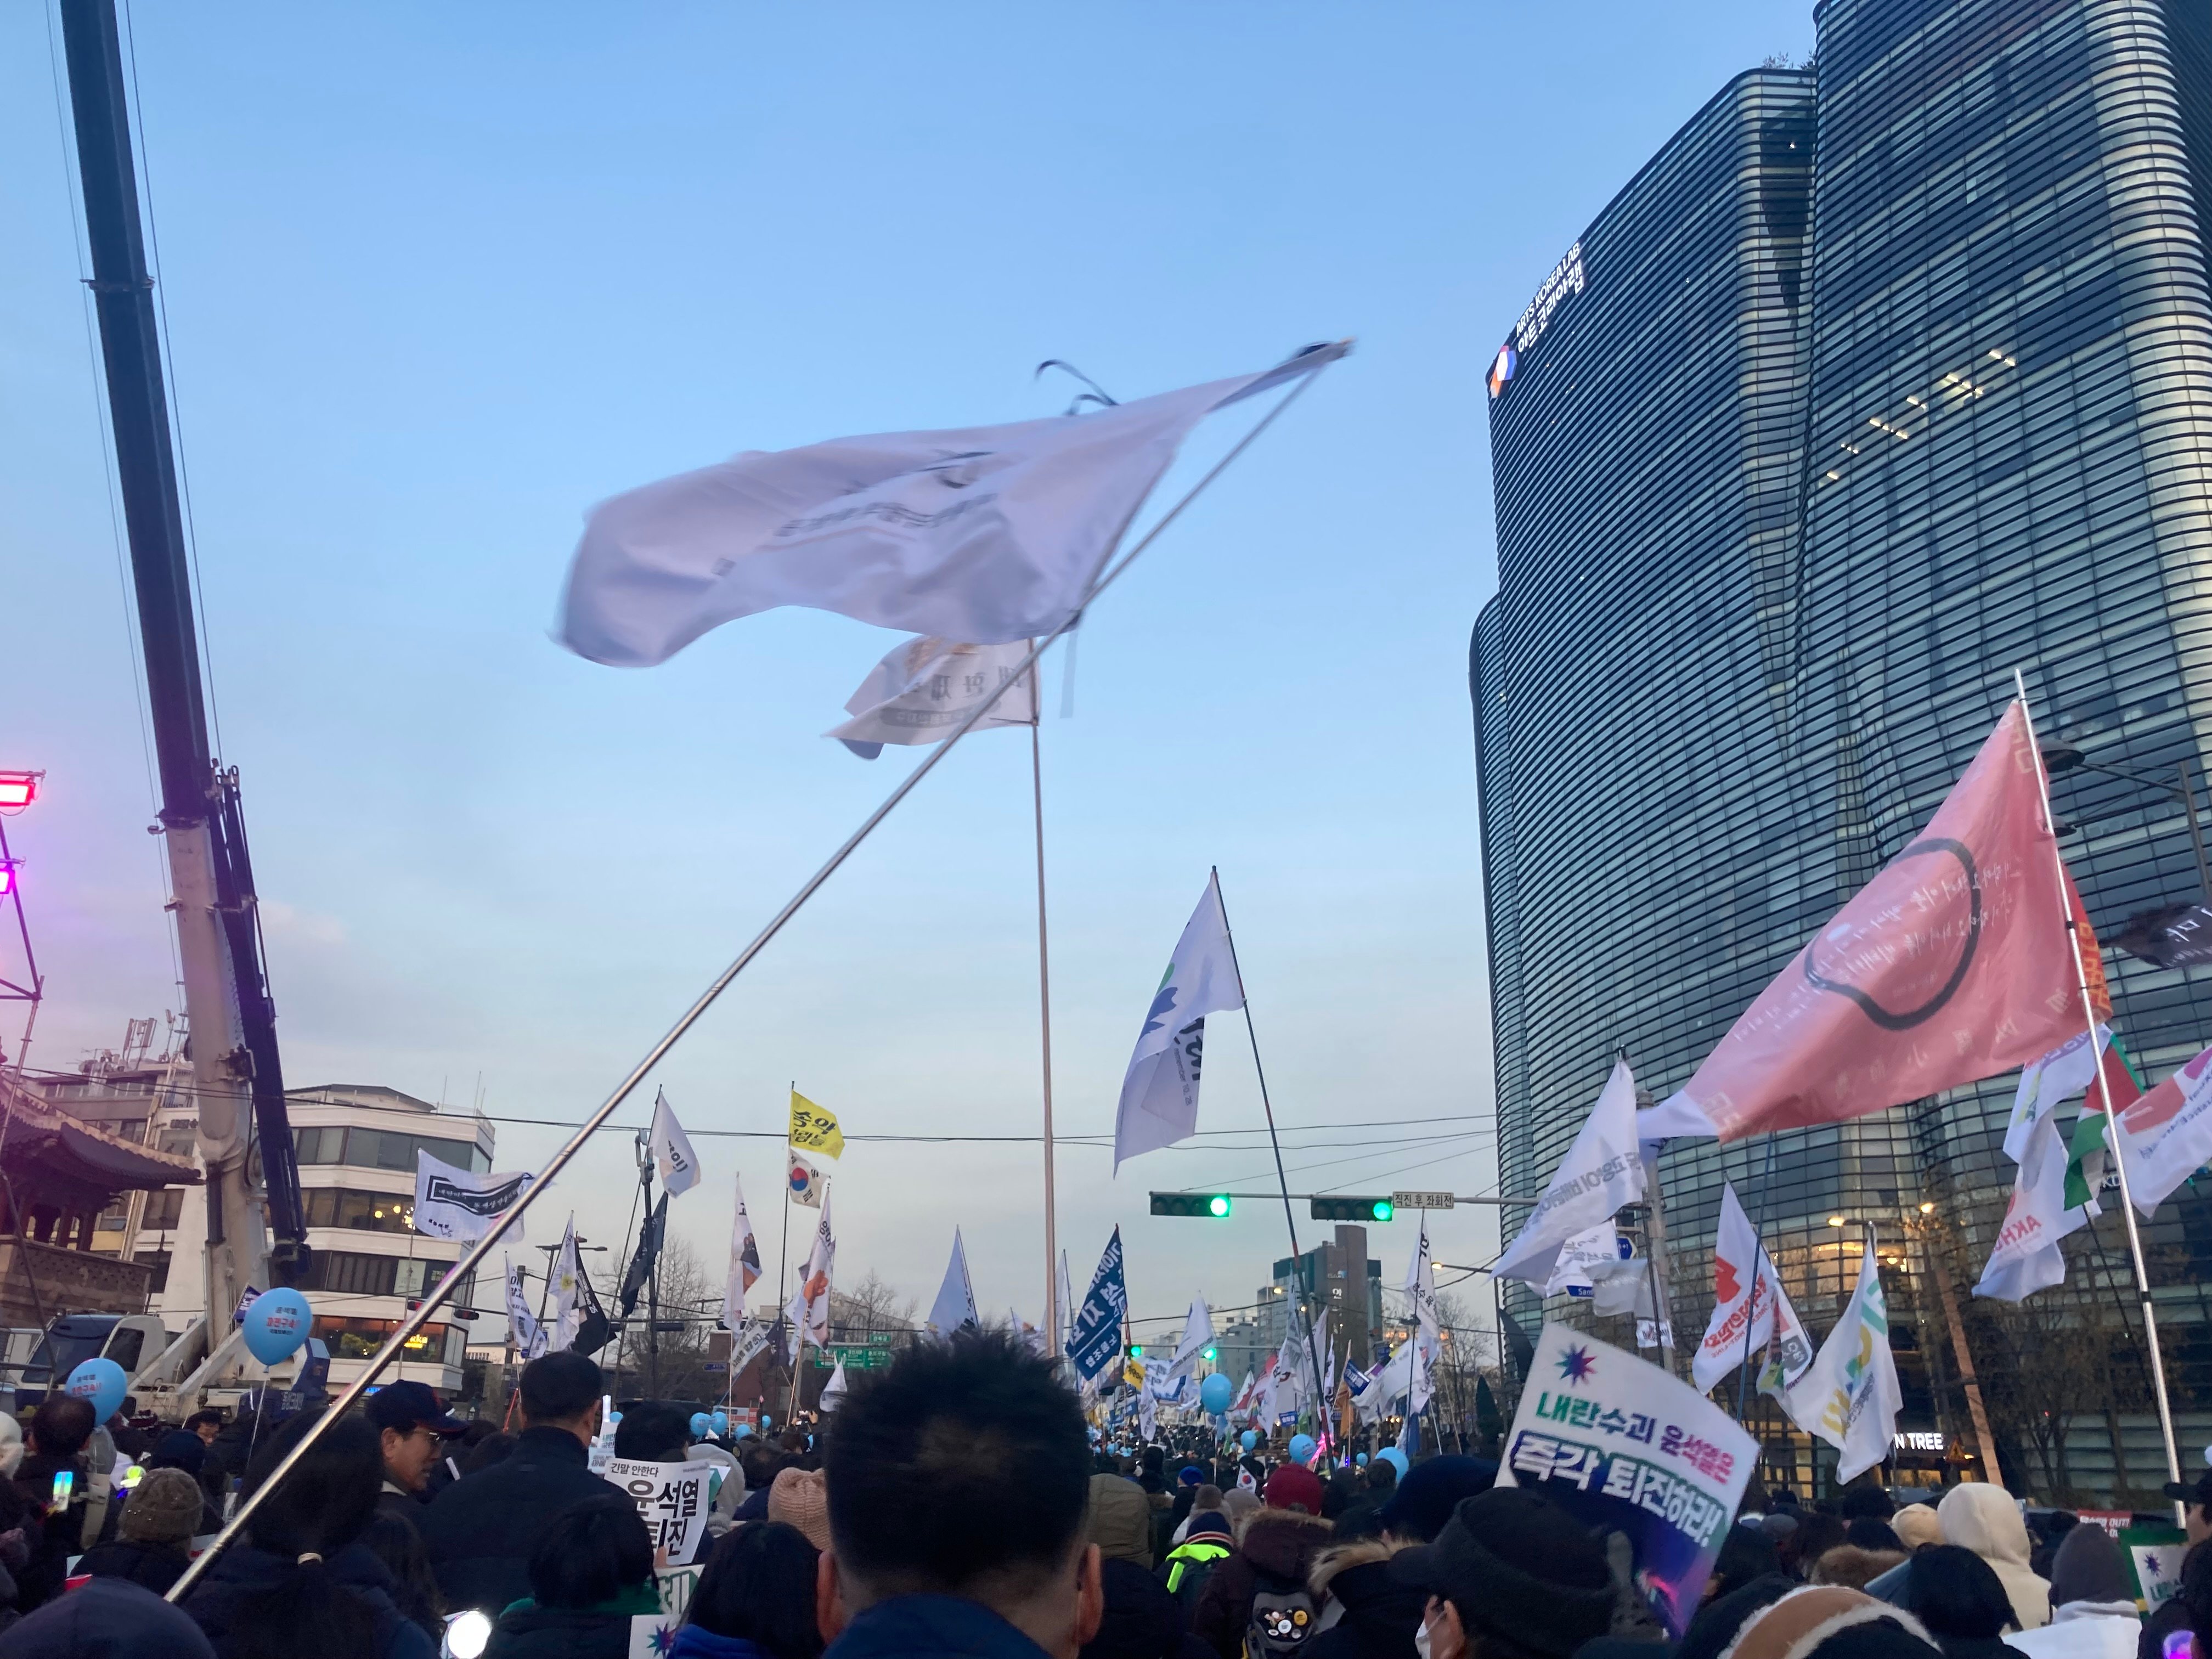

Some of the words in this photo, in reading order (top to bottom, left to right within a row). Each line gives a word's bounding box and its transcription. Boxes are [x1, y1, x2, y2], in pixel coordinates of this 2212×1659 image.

[1516, 302, 1534, 337] ARTS
[1534, 267, 1564, 309] KOREA
[1562, 242, 1581, 272] LAB
[1517, 259, 1584, 353] 아트코리아랩
[1395, 1194, 1412, 1206] 직진
[1415, 1193, 1423, 1206] 후
[1426, 1194, 1452, 1207] 좌회전
[611, 1462, 630, 1475] 긴말
[631, 1465, 659, 1478] 안한다
[1536, 1391, 1657, 1444] 내란수괴
[1660, 1424, 1735, 1486] 윤석열은
[1907, 1432, 1944, 1450] TREE
[627, 1478, 699, 1519] 윤석열
[1510, 1435, 1601, 1491] 즉각
[1601, 1457, 1723, 1549] 퇴진하라!
